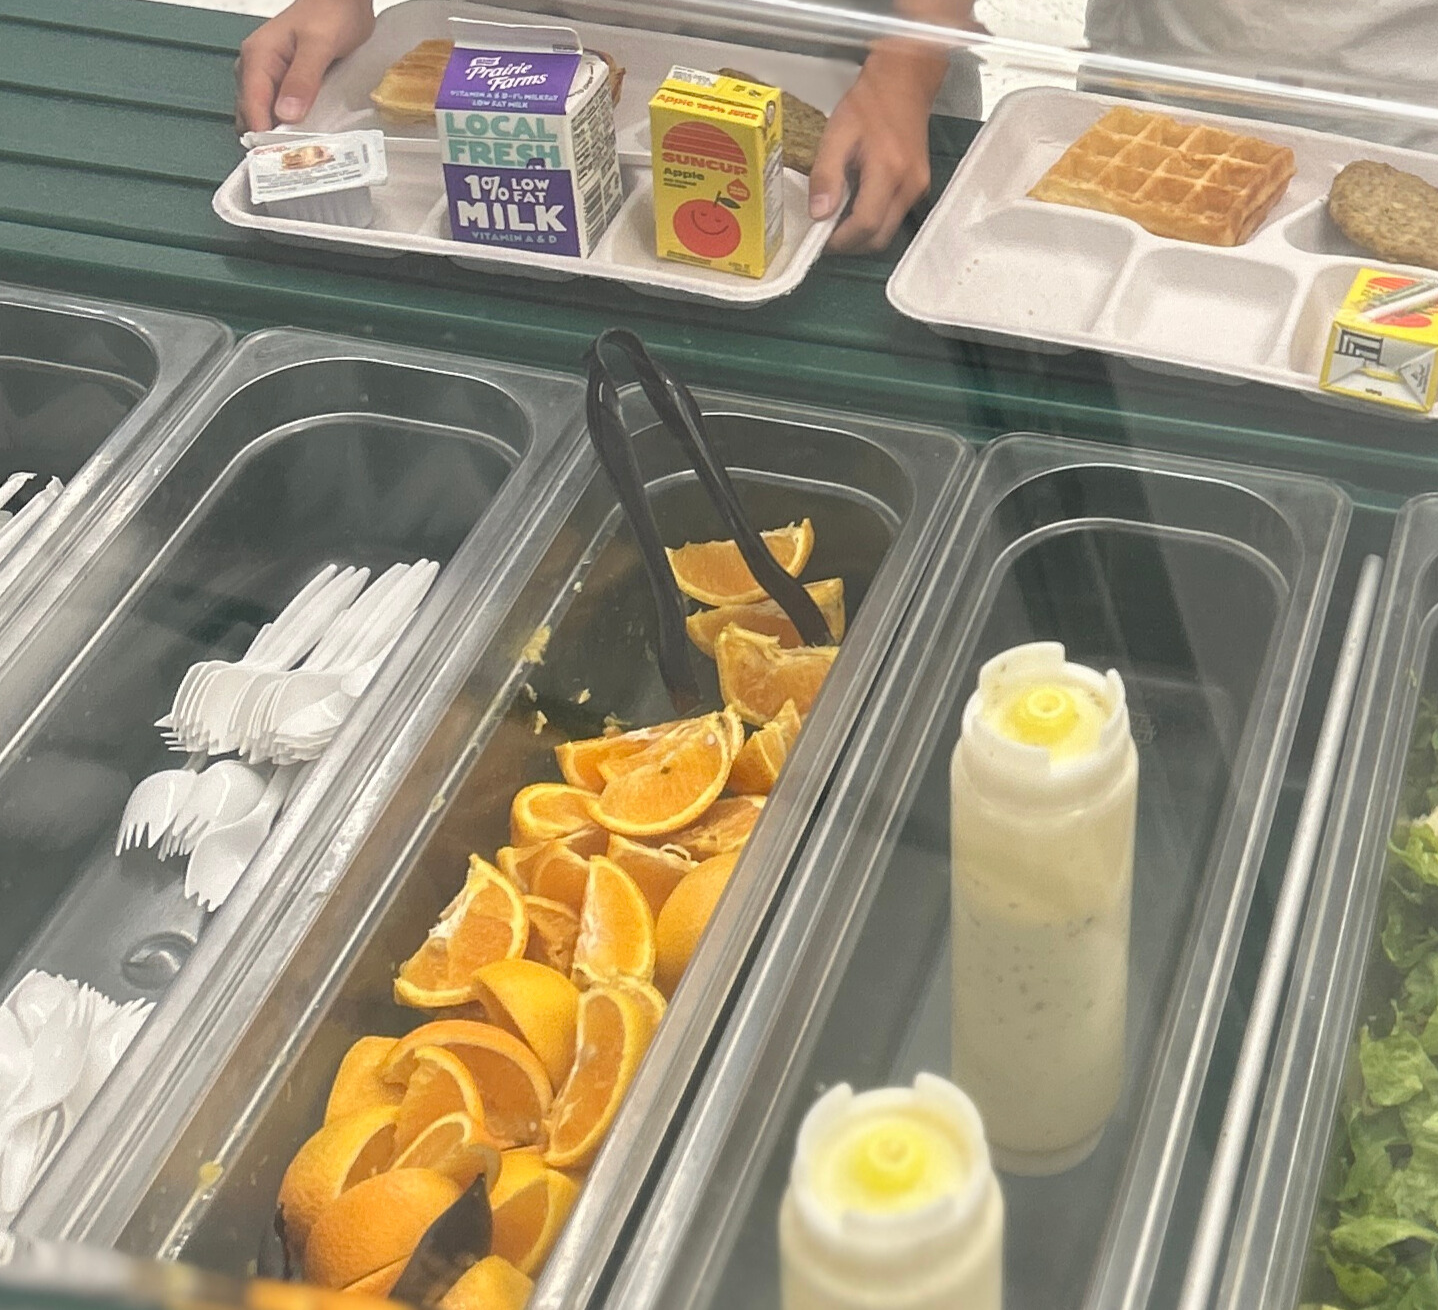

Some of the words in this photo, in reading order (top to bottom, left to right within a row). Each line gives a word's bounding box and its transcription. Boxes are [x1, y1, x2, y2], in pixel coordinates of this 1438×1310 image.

[465, 62, 533, 81] Prairie
[487, 73, 548, 92] Farms
[656, 93, 693, 107] Apple
[445, 112, 558, 140] LOCAL
[448, 139, 561, 168] FRESH
[662, 152, 749, 176] SUNCUP
[663, 167, 705, 181] Apple
[464, 175, 510, 201] 1%
[511, 178, 550, 191] LOW
[513, 191, 547, 203] FAT
[457, 200, 567, 232] MILK
[471, 231, 522, 242] VITAMIN
[525, 234, 533, 243] A
[536, 235, 545, 243] &
[549, 235, 557, 244] D
